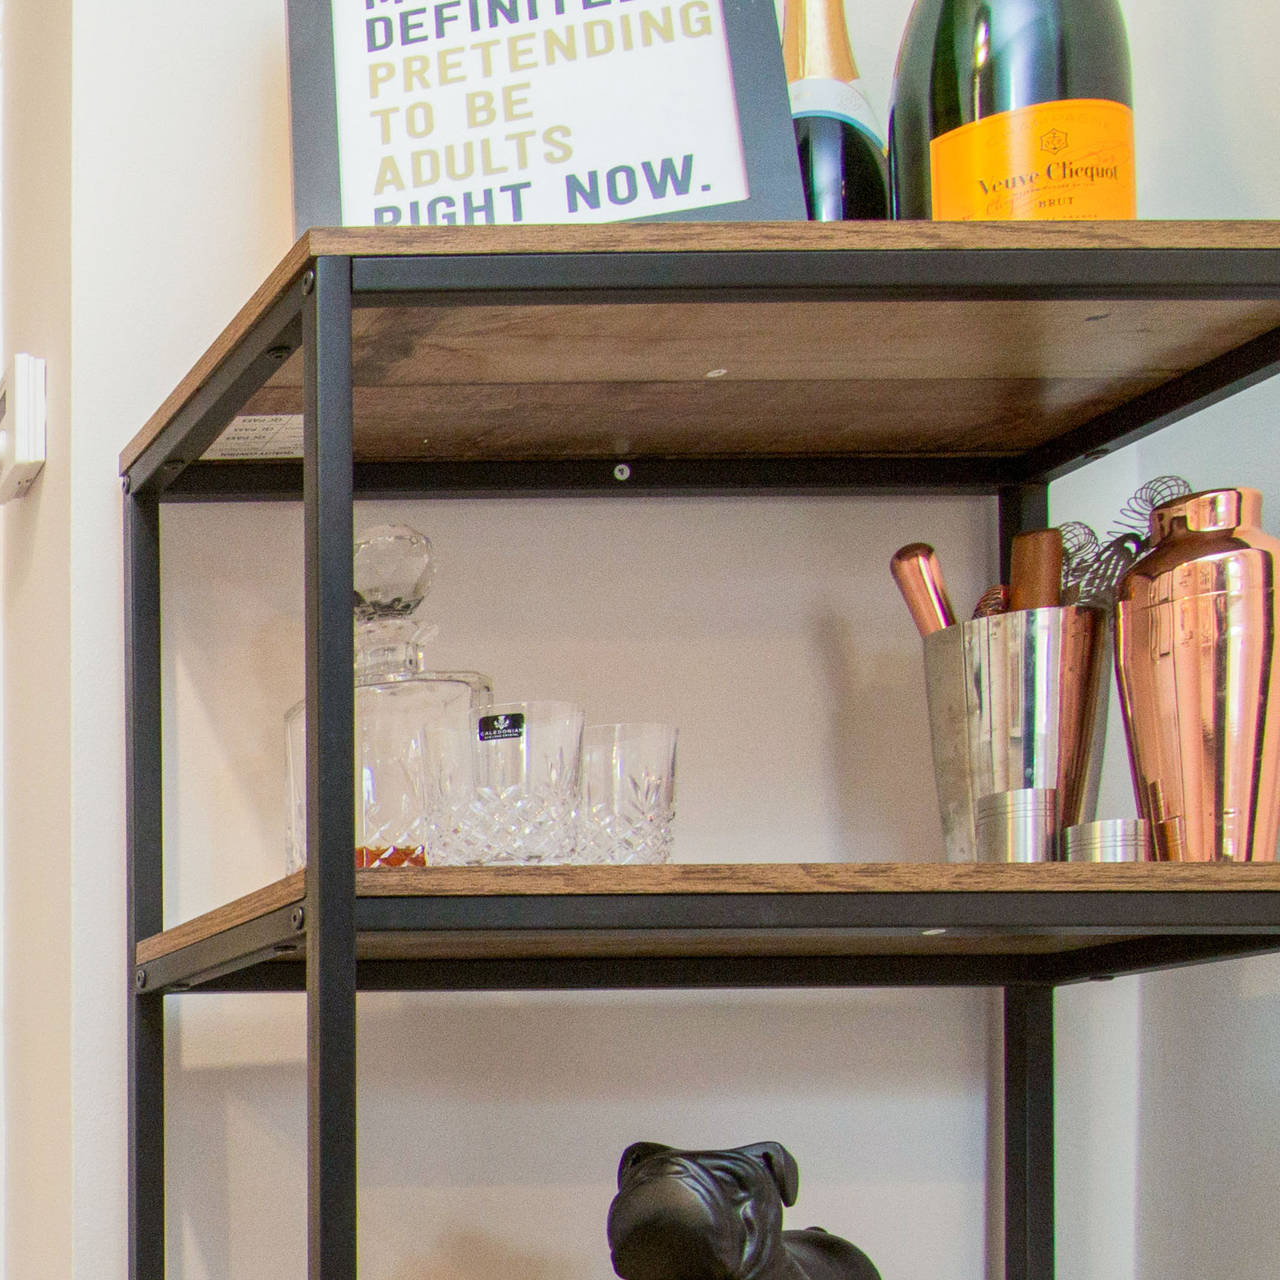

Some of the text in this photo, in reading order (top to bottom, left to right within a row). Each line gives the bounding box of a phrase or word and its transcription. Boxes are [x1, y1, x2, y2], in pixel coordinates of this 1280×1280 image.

[369, 1, 713, 99] PRETENDING
[370, 82, 534, 145] TO BE
[373, 125, 573, 195] ADULTS
[565, 153, 711, 213] NOW.
[979, 171, 1040, 196] Veuve
[1046, 161, 1119, 182] Clicquot
[1038, 197, 1074, 209] BRUT
